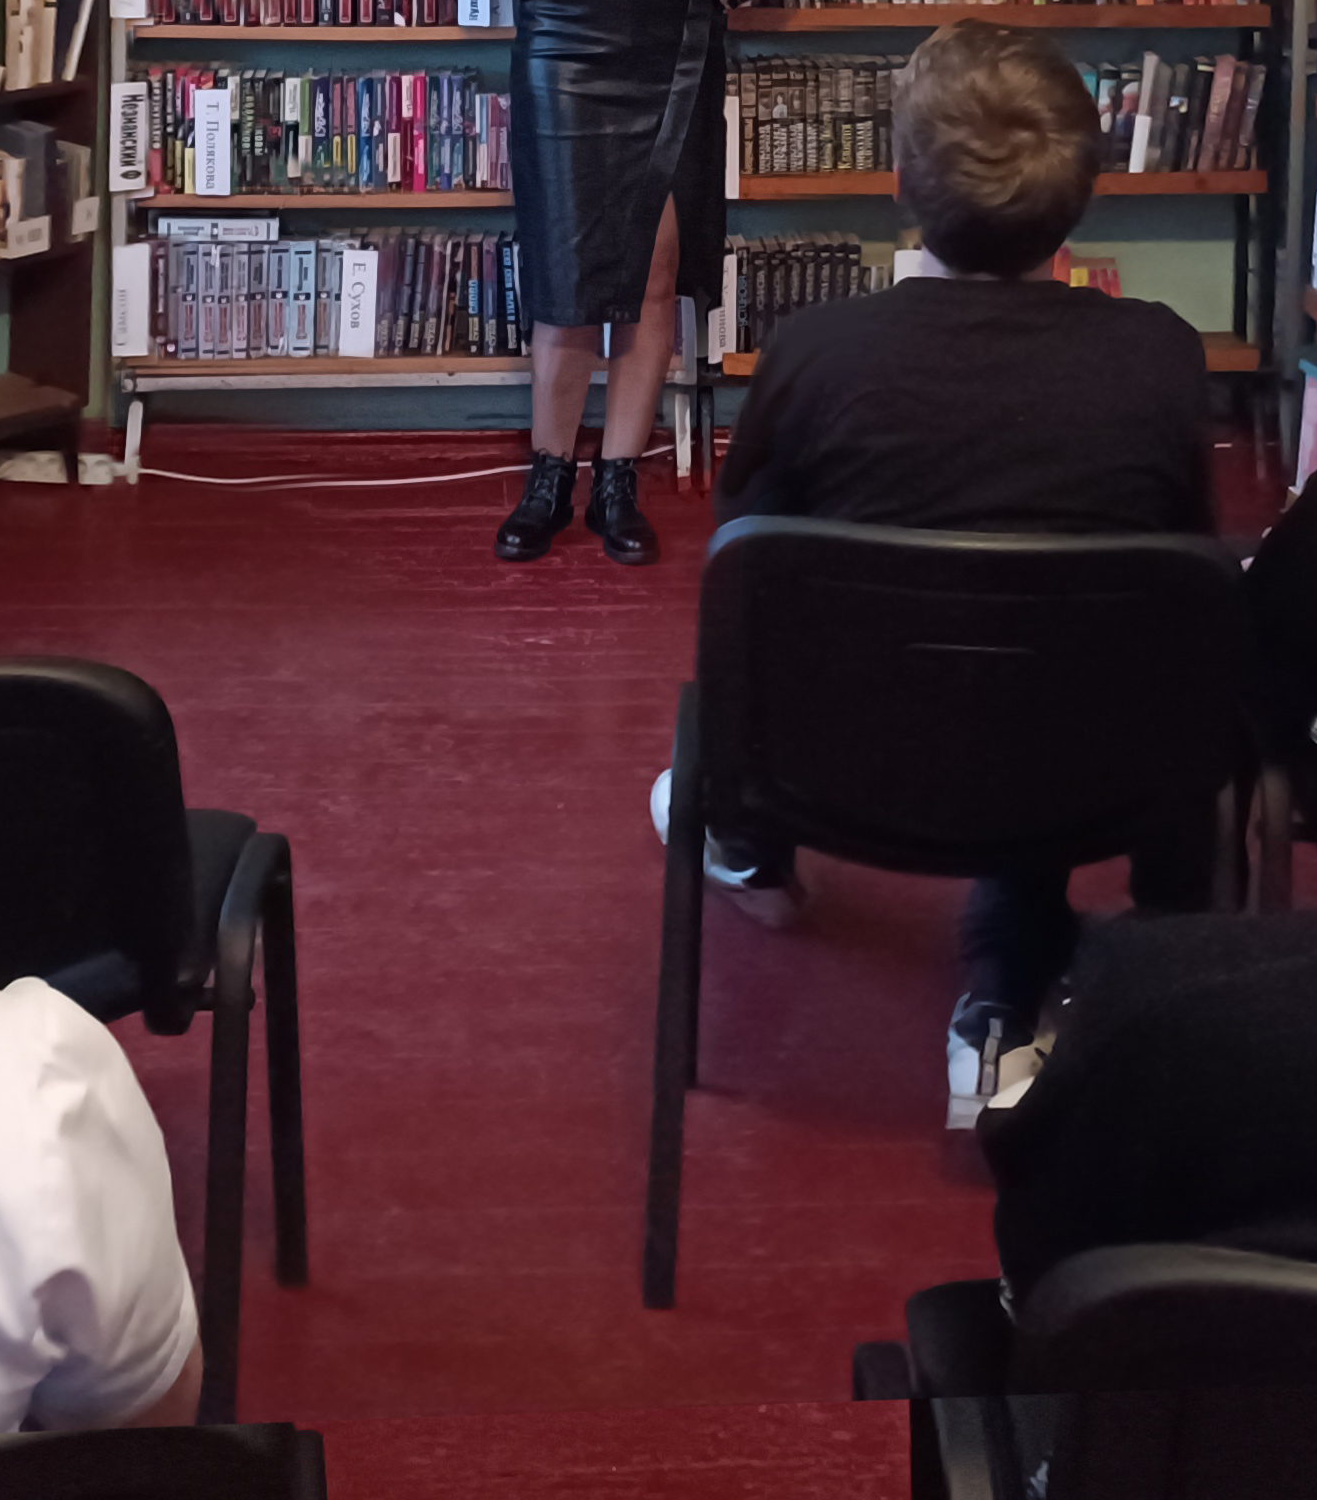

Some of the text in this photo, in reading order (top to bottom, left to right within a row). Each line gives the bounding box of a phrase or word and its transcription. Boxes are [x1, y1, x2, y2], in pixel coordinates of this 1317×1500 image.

[119, 94, 145, 168] Незнанский
[204, 120, 219, 190] Полякова
[347, 281, 366, 329] Сухов
